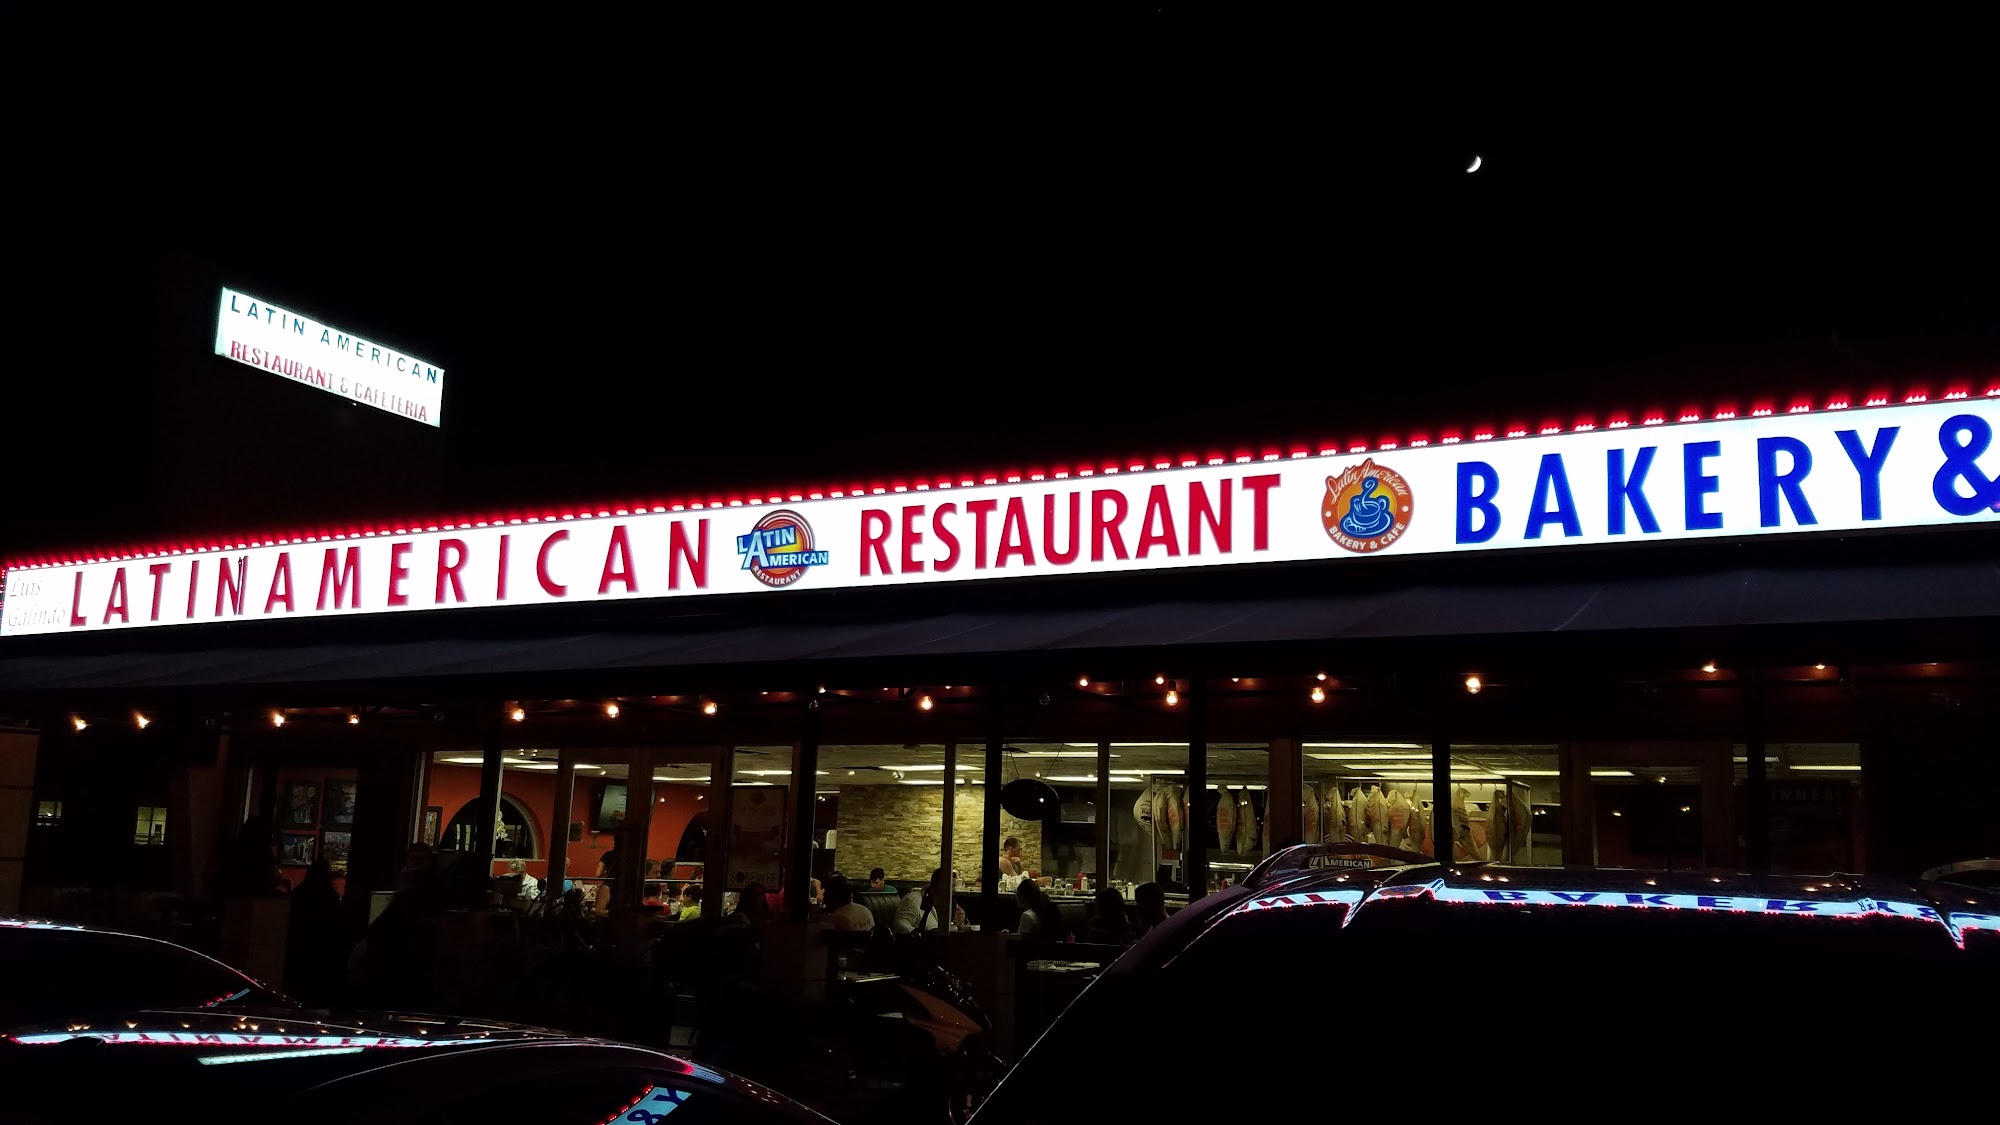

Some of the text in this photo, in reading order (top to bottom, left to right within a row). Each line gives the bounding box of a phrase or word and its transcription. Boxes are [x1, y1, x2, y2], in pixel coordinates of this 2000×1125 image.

[231, 295, 437, 384] LATIN AMERICAN
[230, 340, 334, 391] RESTAURANT
[354, 382, 428, 422] CAFETERIA
[1327, 460, 1408, 505] Latin American
[1455, 414, 2000, 545] BAKERY &
[737, 527, 796, 568] LATIN
[743, 531, 828, 568] AMERICAN
[859, 473, 1281, 577] RESTAURANT
[1329, 522, 1405, 550] BAKERY & CAFE
[69, 518, 711, 627] LATIN AMERICAN
[753, 565, 801, 585] RESTAURANT
